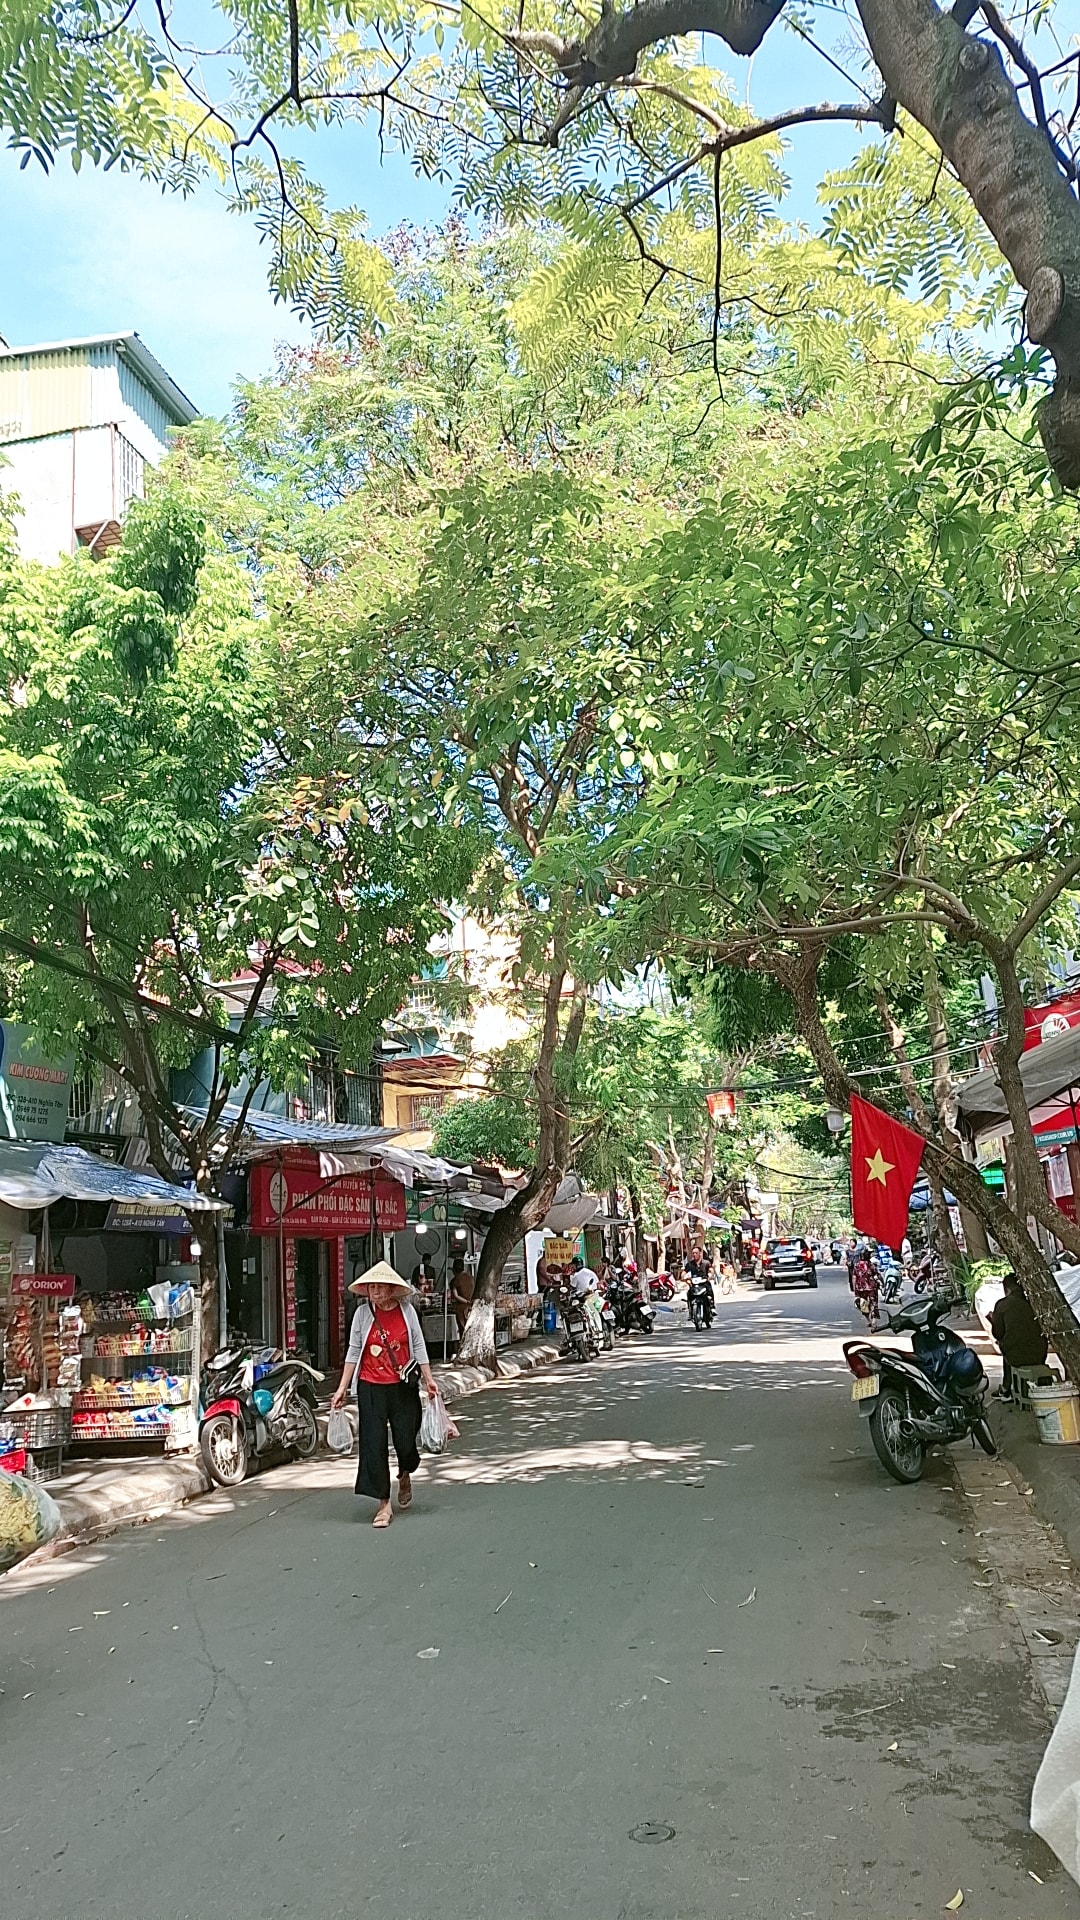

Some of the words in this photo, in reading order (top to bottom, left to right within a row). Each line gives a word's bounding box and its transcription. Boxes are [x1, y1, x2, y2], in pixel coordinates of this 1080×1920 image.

[9, 1062, 24, 1077] KIM
[49, 1069, 69, 1085] MART
[292, 1190, 316, 1210] PHÂN
[318, 1190, 337, 1211] PHỐI
[338, 1194, 354, 1215] ĐẶC
[33, 1280, 63, 1290] ORION
